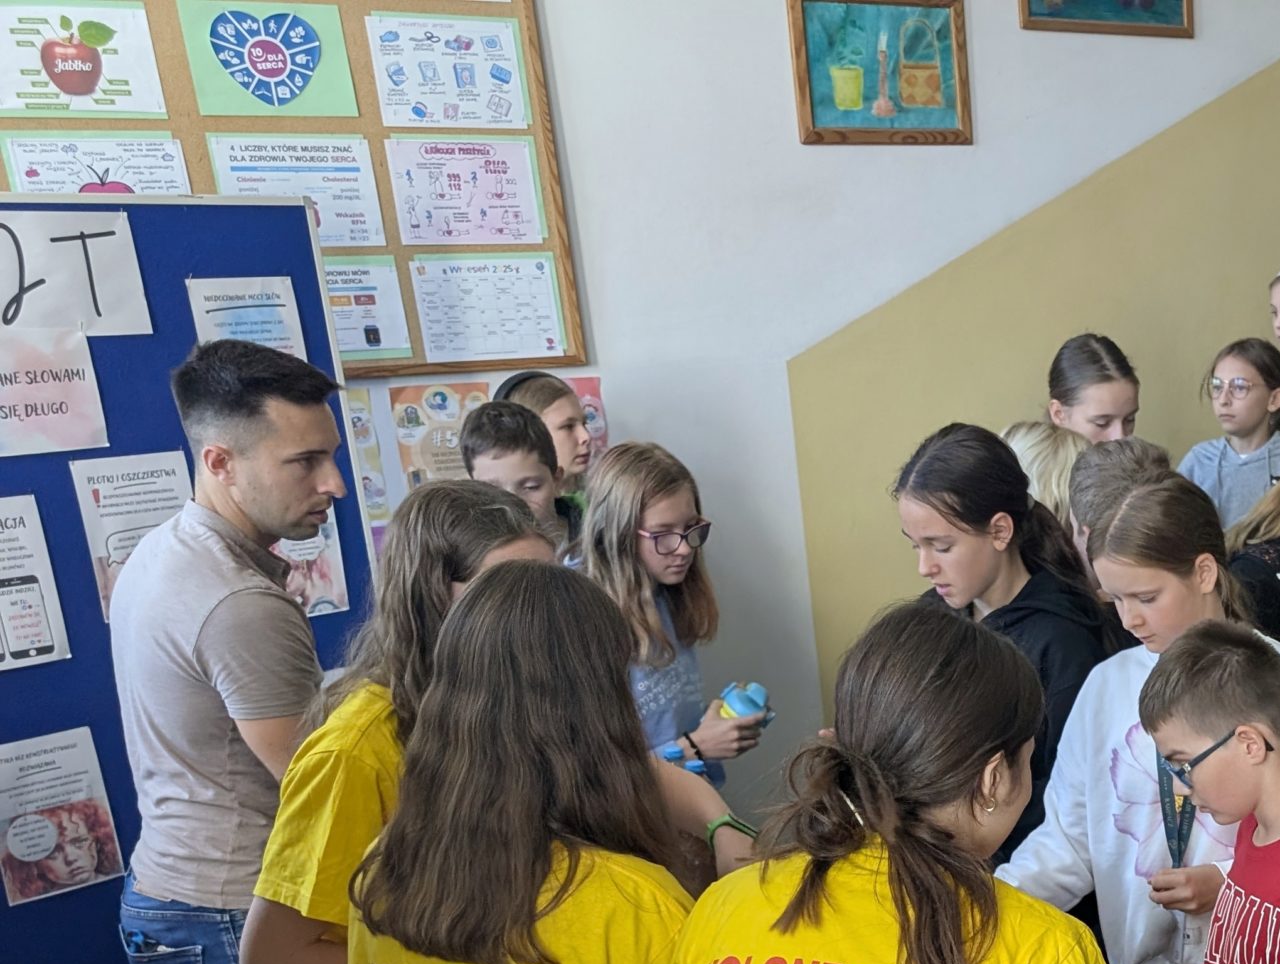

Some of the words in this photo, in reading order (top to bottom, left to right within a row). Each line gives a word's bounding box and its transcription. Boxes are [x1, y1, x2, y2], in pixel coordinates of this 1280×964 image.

[267, 53, 285, 61] DLA
[256, 61, 285, 70] SERCA
[240, 145, 270, 153] LICZBY,
[272, 144, 299, 153] KTÓRE
[300, 145, 330, 153] MUSISZ
[332, 144, 353, 154] ZNAĆ
[229, 155, 247, 163] DLA
[250, 155, 286, 163] ZDROWIA
[290, 155, 328, 164] TWOJEGO
[25, 367, 86, 385] SŁOWAMI
[0, 405, 24, 422] SIĘ
[25, 400, 69, 417] DŁUGO
[120, 467, 177, 482] OSZCZERSTWA
